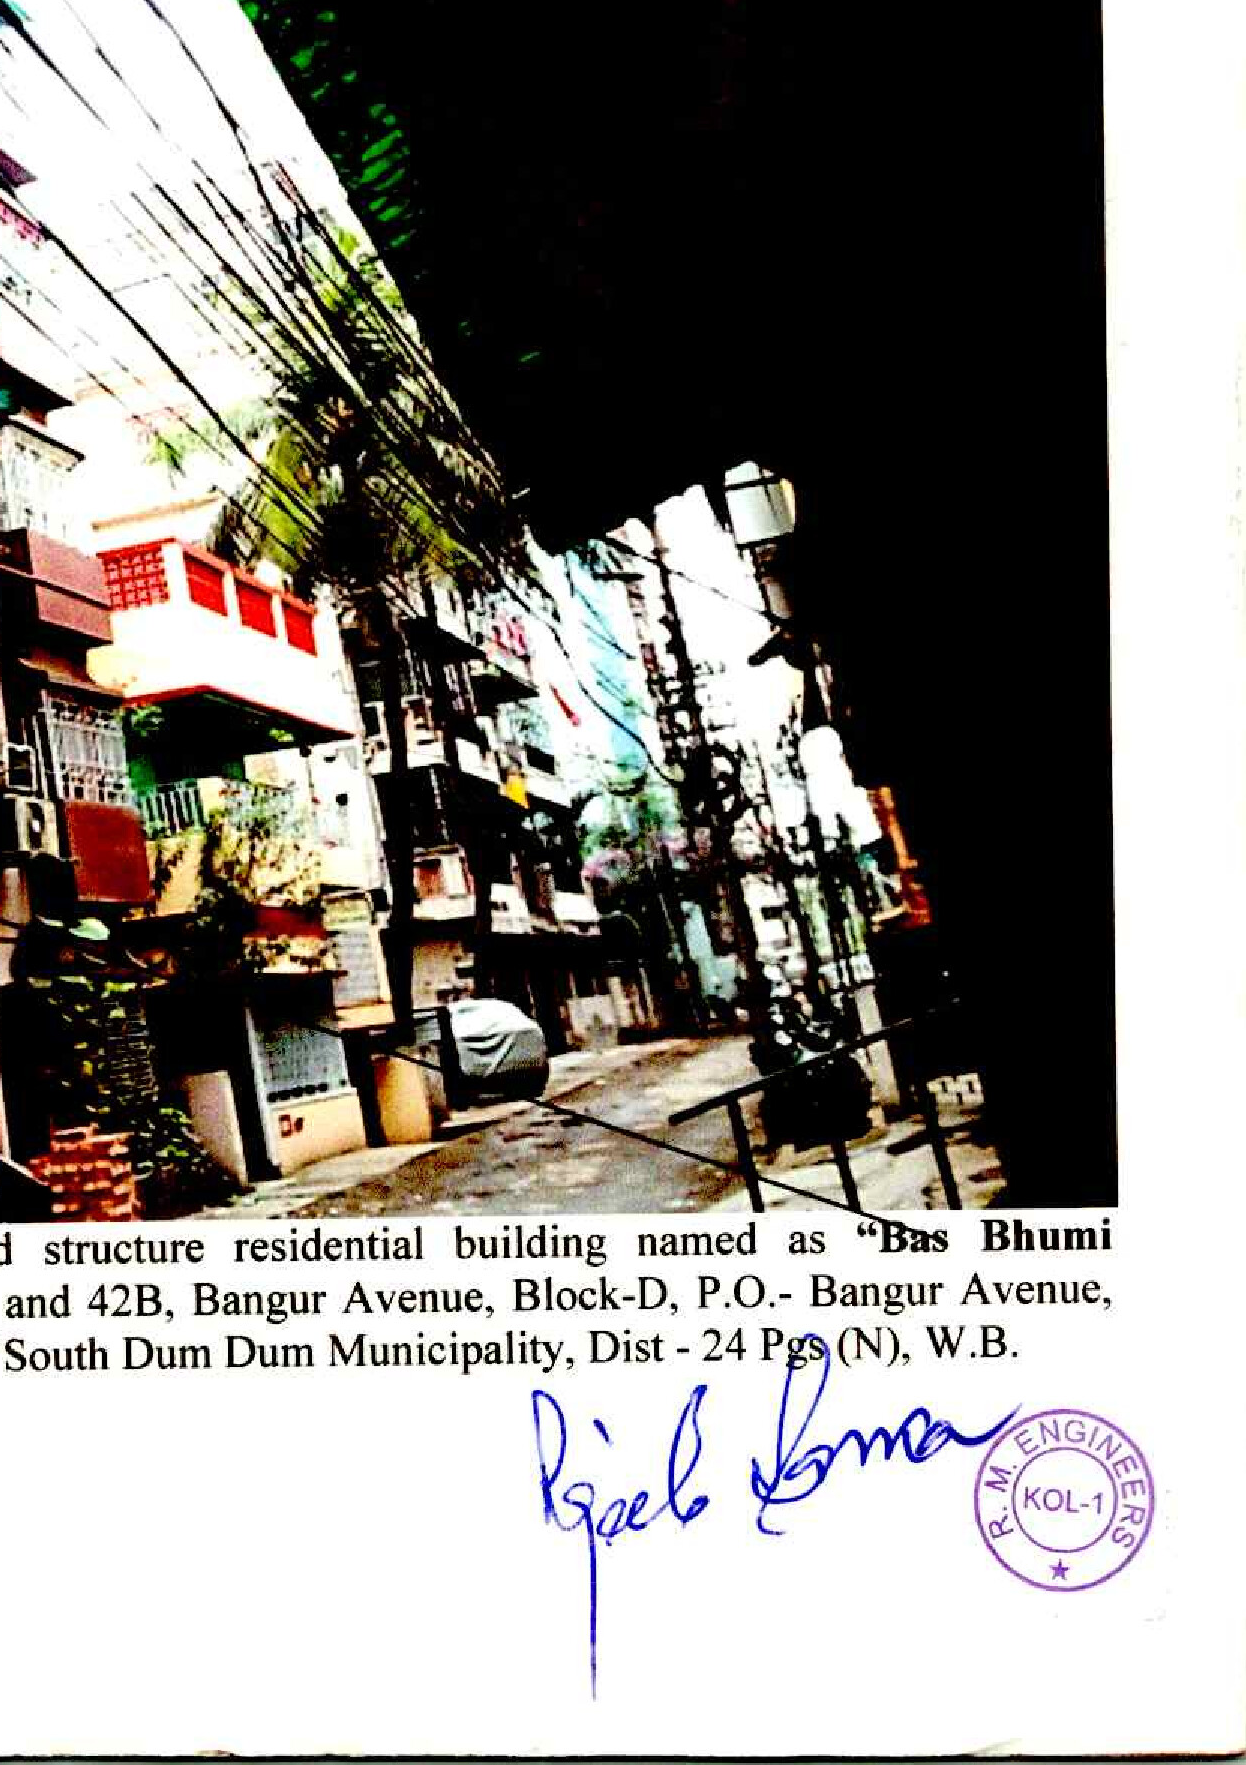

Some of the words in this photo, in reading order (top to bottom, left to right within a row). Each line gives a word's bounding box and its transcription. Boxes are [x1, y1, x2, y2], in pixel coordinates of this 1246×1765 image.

[45, 1237, 204, 1265] structure
[236, 1226, 422, 1262] residential
[456, 1225, 606, 1267] building
[638, 1222, 756, 1256] named
[789, 1232, 825, 1253] as
[857, 1217, 948, 1252] “Bas
[981, 1217, 1110, 1250] Bhumi
[6, 1285, 69, 1318] and
[89, 1285, 173, 1319] 42B,
[194, 1283, 326, 1324] Bangur
[342, 1282, 494, 1317] Avenue,
[515, 1277, 677, 1315] Block-D,
[699, 1276, 791, 1307] P.O.-
[812, 1274, 942, 1315] Bangur
[962, 1273, 1110, 1309] Avenue,
[5, 1337, 108, 1372] South
[123, 1337, 210, 1369] Dum
[227, 1336, 314, 1367] Dum
[330, 1331, 573, 1375] Municipality,
[590, 1330, 663, 1363] Dist
[704, 1328, 746, 1361] 24
[762, 1328, 824, 1370] Pgs
[839, 1327, 909, 1366] (N),
[926, 1325, 1017, 1357] W.B.
[1013, 1418, 1147, 1549] ENGINEERS
[1023, 1486, 1104, 1515] KOL-1
